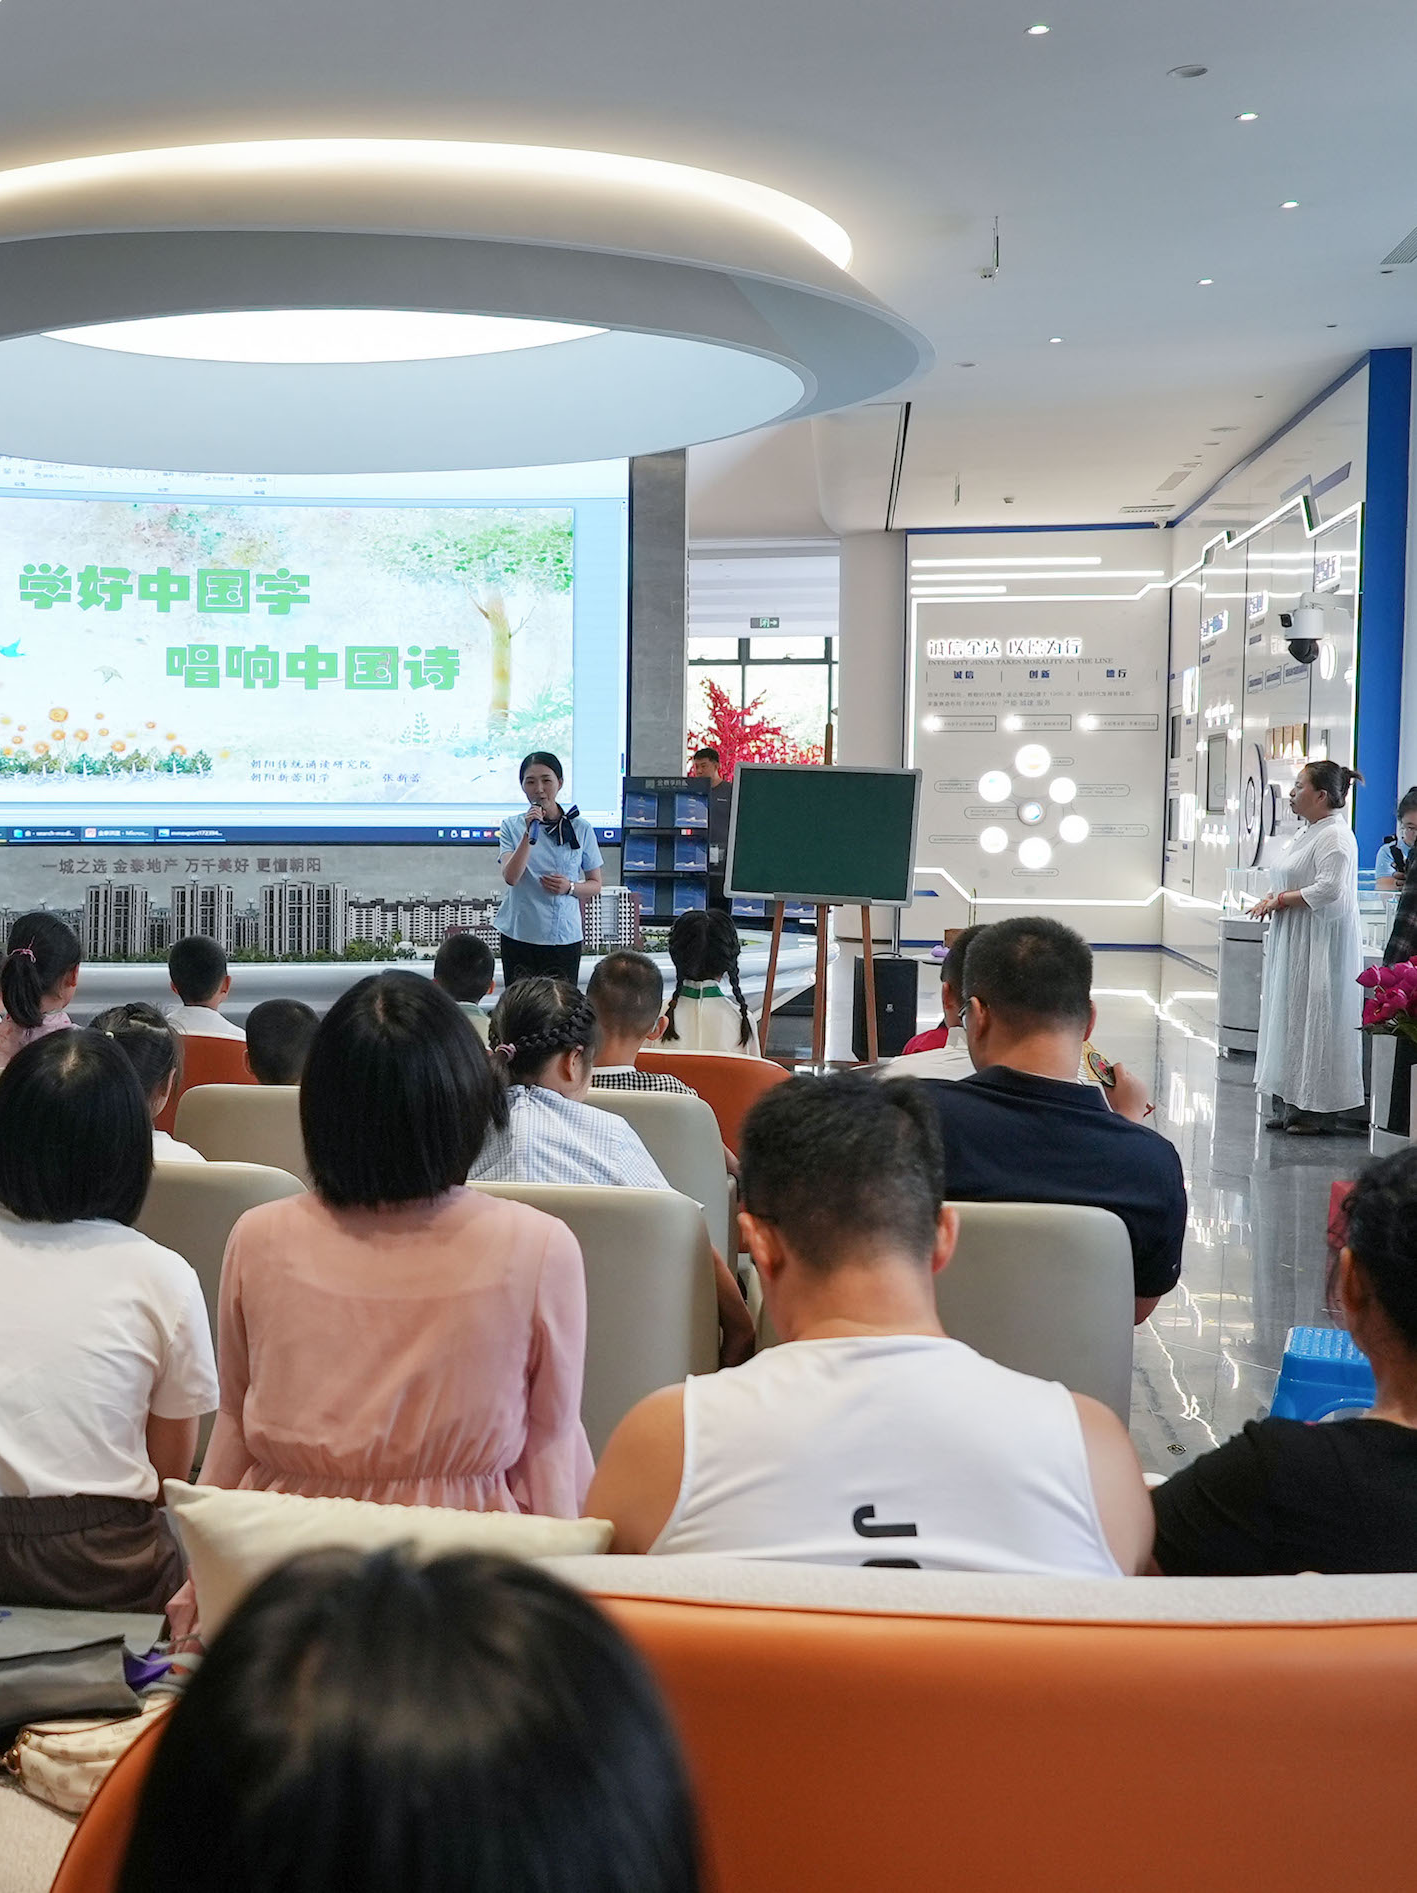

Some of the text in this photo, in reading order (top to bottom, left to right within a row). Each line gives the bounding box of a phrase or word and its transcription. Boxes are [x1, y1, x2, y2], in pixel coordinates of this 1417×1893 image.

[18, 563, 311, 615] 学好中国字
[166, 644, 461, 691] 唱响中国诗
[41, 857, 322, 875] 一城之选 金泰地产 万千美好 更懂朝阳
